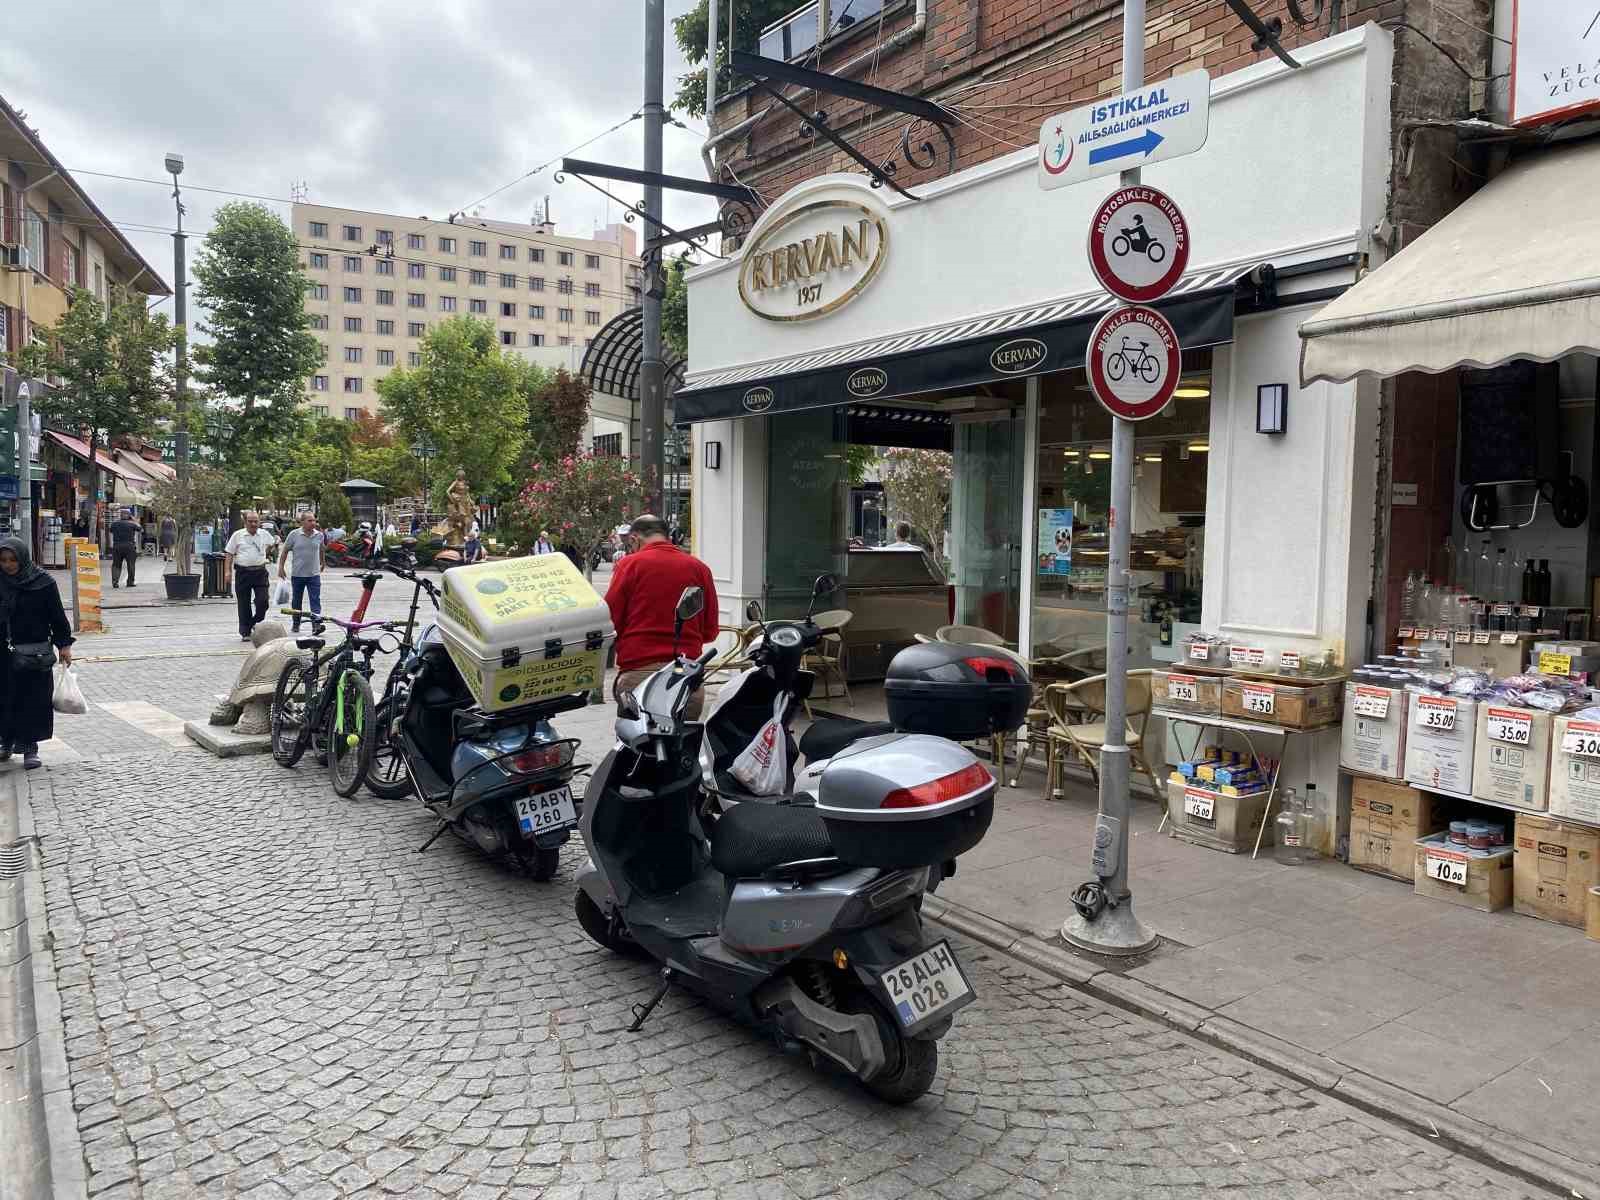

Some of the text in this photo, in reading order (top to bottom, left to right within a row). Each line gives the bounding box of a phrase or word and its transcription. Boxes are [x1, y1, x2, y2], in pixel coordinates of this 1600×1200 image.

[1091, 88, 1169, 124] İSTİKLAL
[1143, 99, 1190, 125] MERKEZİ
[1097, 190, 1184, 250] MOTOSİKLET GİREMEZ
[752, 219, 870, 290] KERVAN
[798, 283, 823, 306] 1957
[1135, 311, 1174, 350] GİREMEZ
[996, 344, 1041, 365] KERVAN
[850, 374, 884, 390] KERVAN
[746, 393, 771, 405] KERVAN
[1251, 699, 1272, 713] 7.50
[1500, 725, 1527, 741] 35.00
[534, 808, 561, 827] 260
[912, 980, 949, 1013] 028
